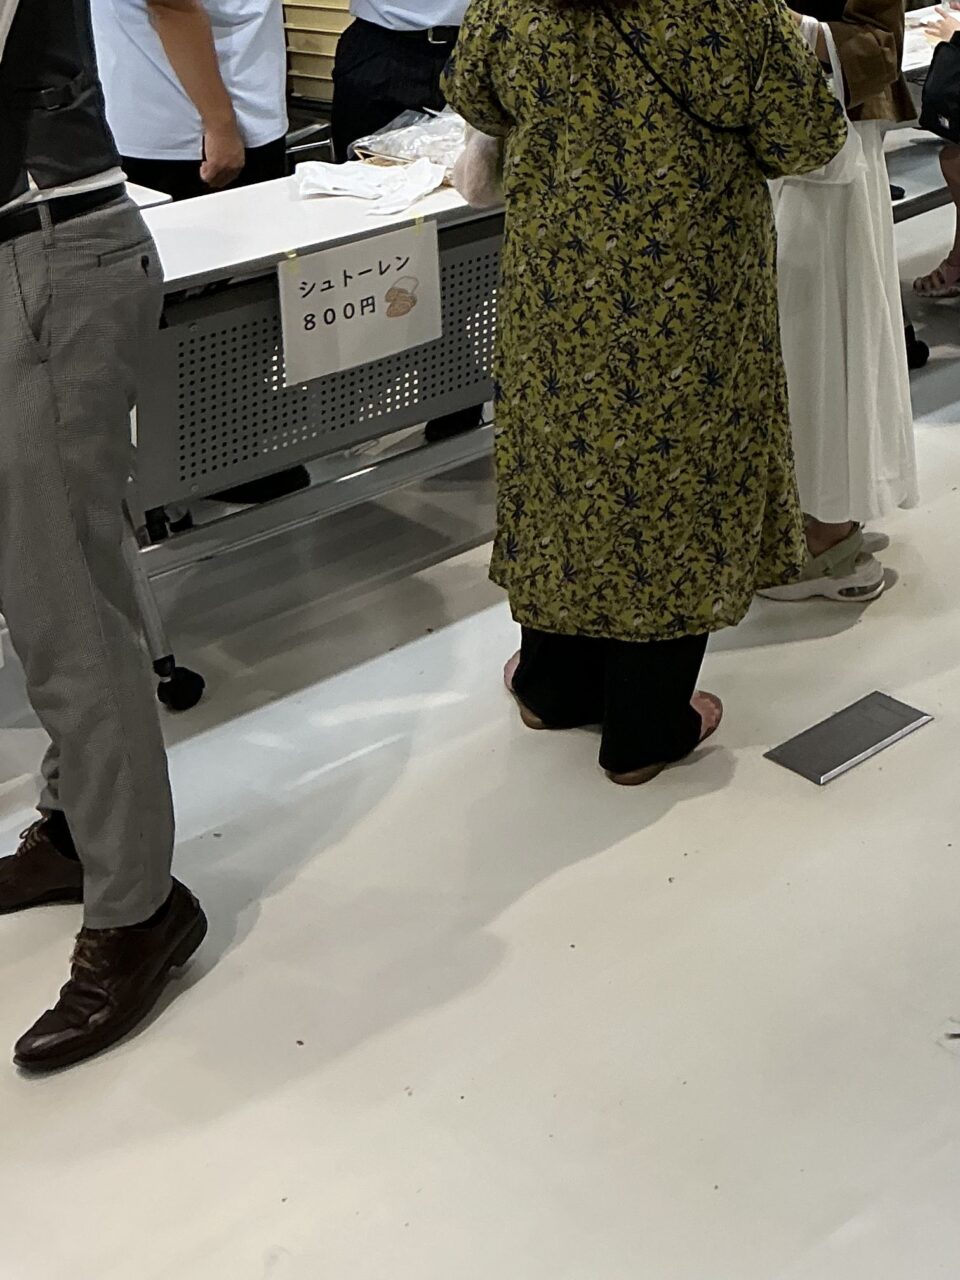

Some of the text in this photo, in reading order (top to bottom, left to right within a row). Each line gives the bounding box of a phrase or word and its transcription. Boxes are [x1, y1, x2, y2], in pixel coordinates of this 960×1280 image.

[299, 256, 410, 298] シュトーレン
[303, 296, 376, 331] 800円
